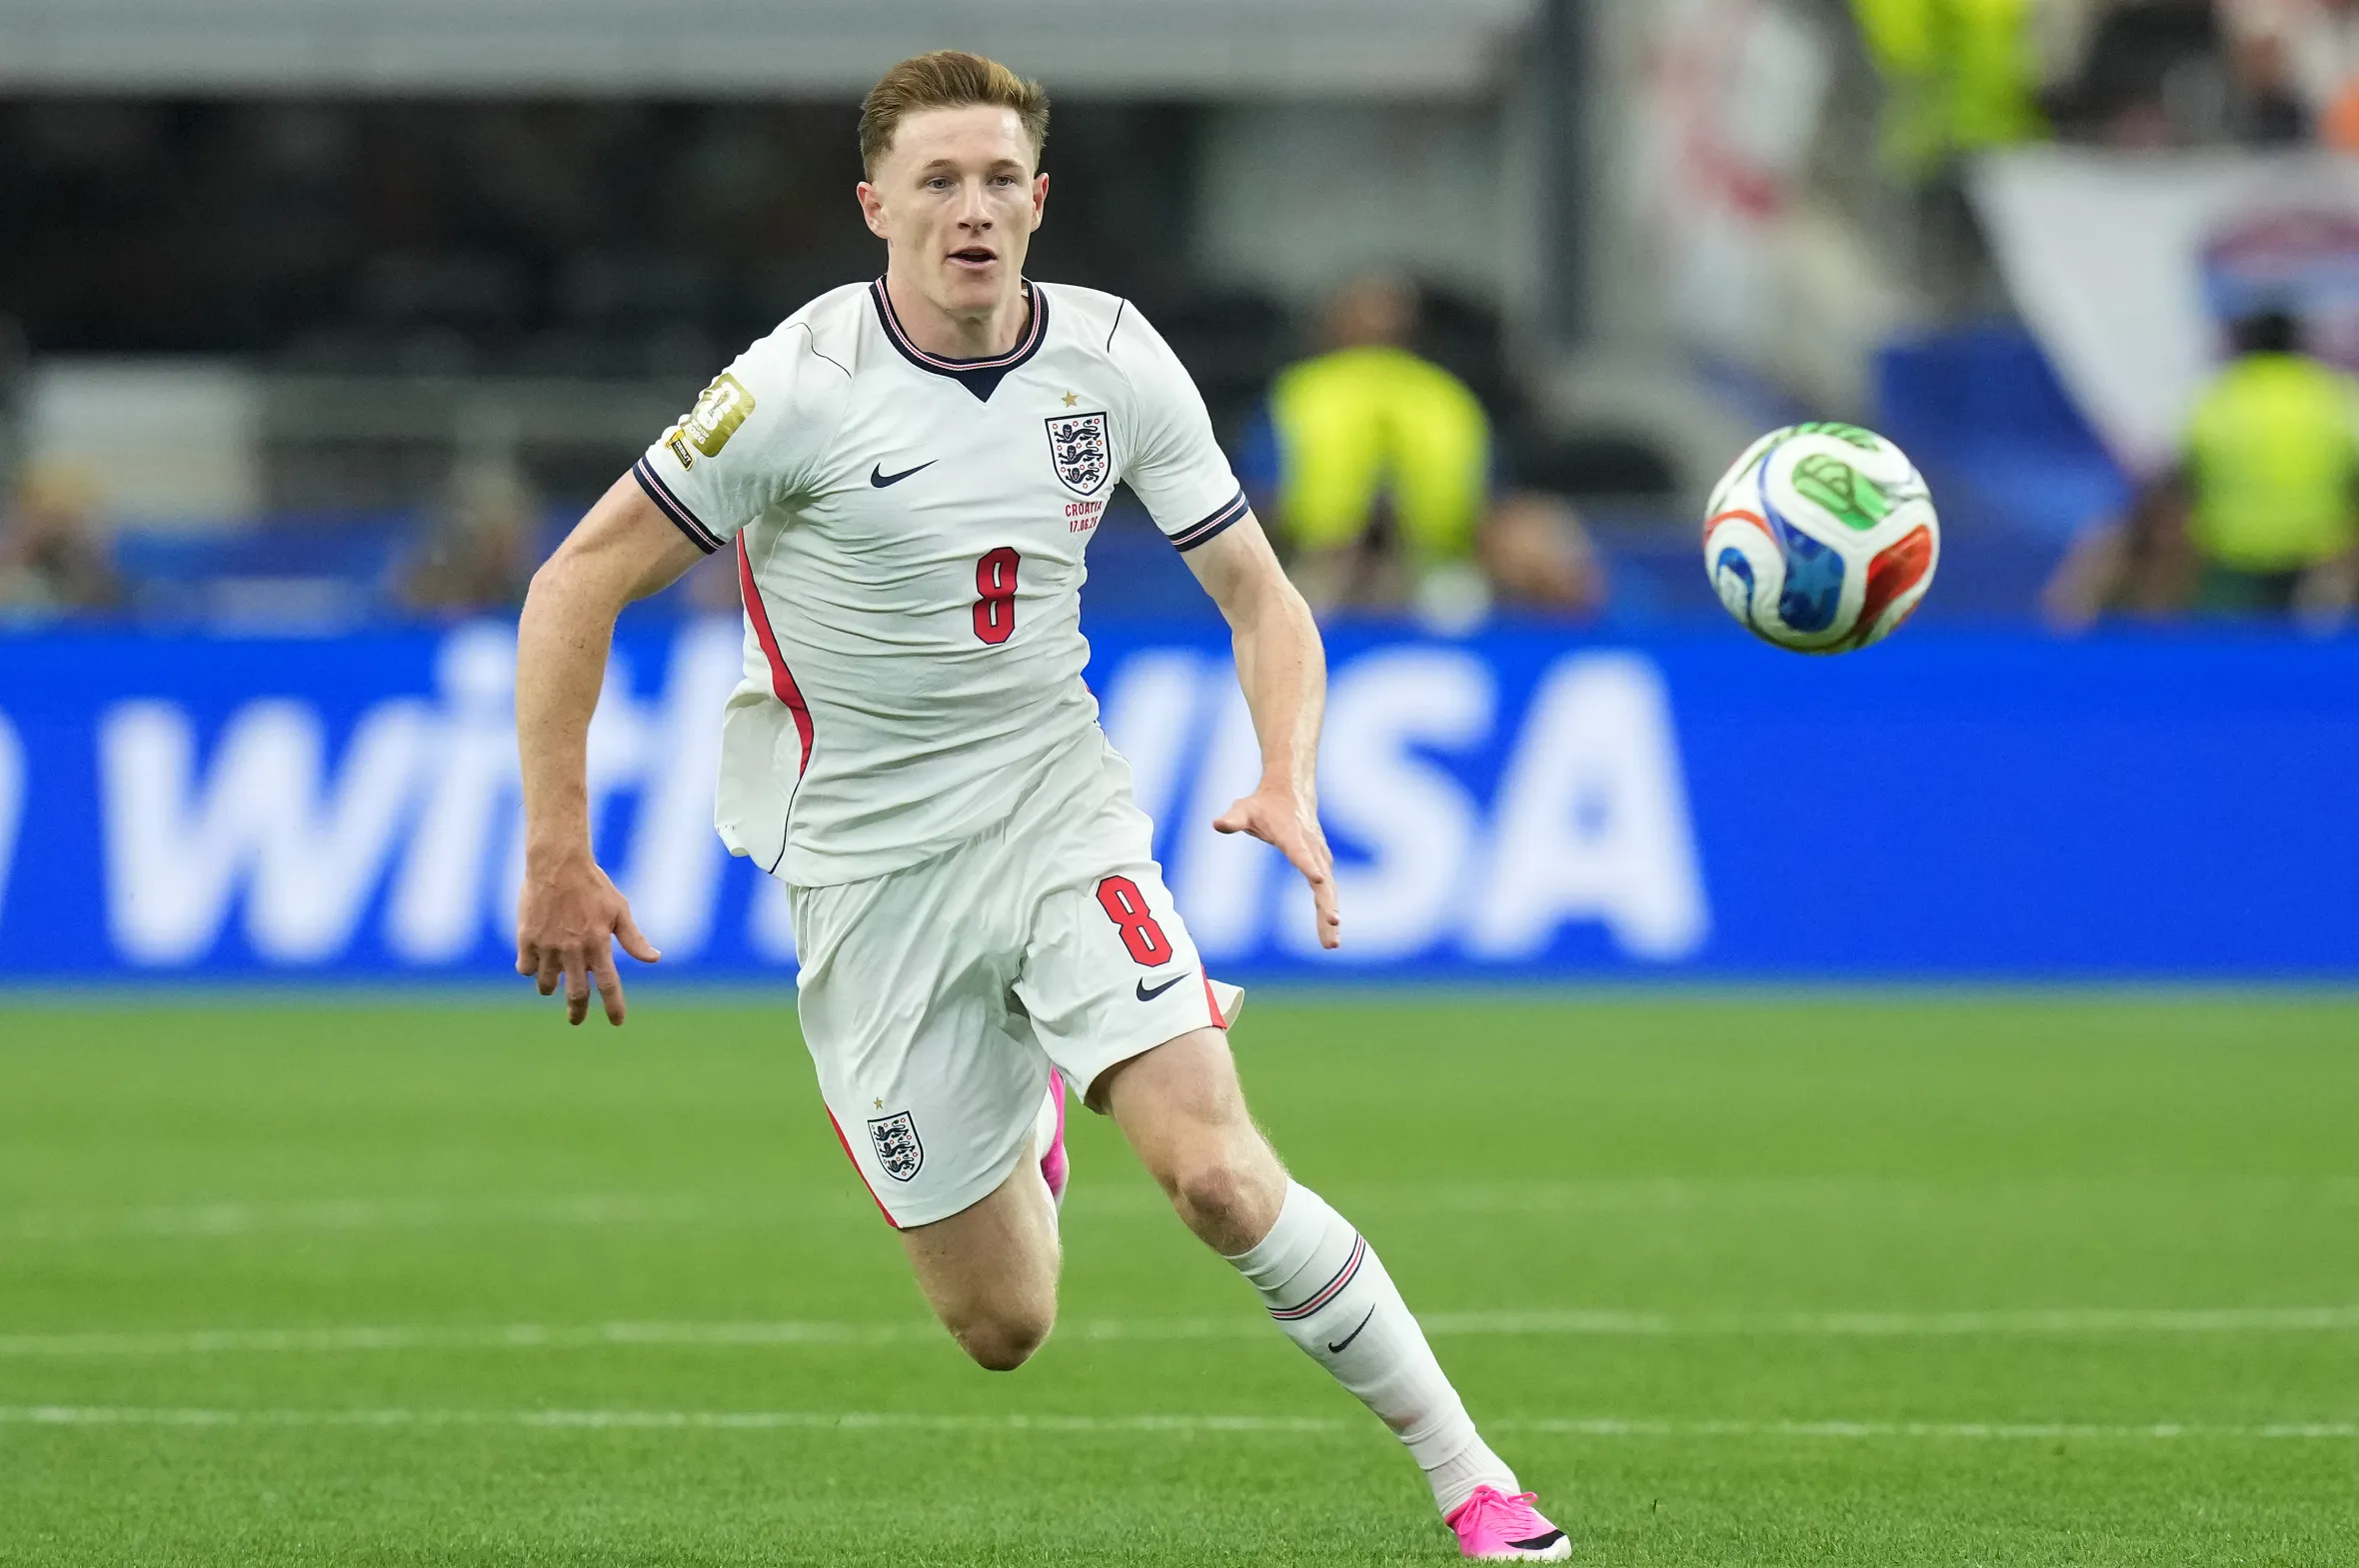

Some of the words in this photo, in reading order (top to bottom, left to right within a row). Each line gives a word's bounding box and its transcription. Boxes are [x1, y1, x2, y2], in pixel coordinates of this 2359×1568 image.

[675, 440, 692, 463] DEBUT
[1065, 501, 1102, 517] CROATIA
[973, 547, 1021, 645] 8
[1096, 875, 1173, 967] 8
